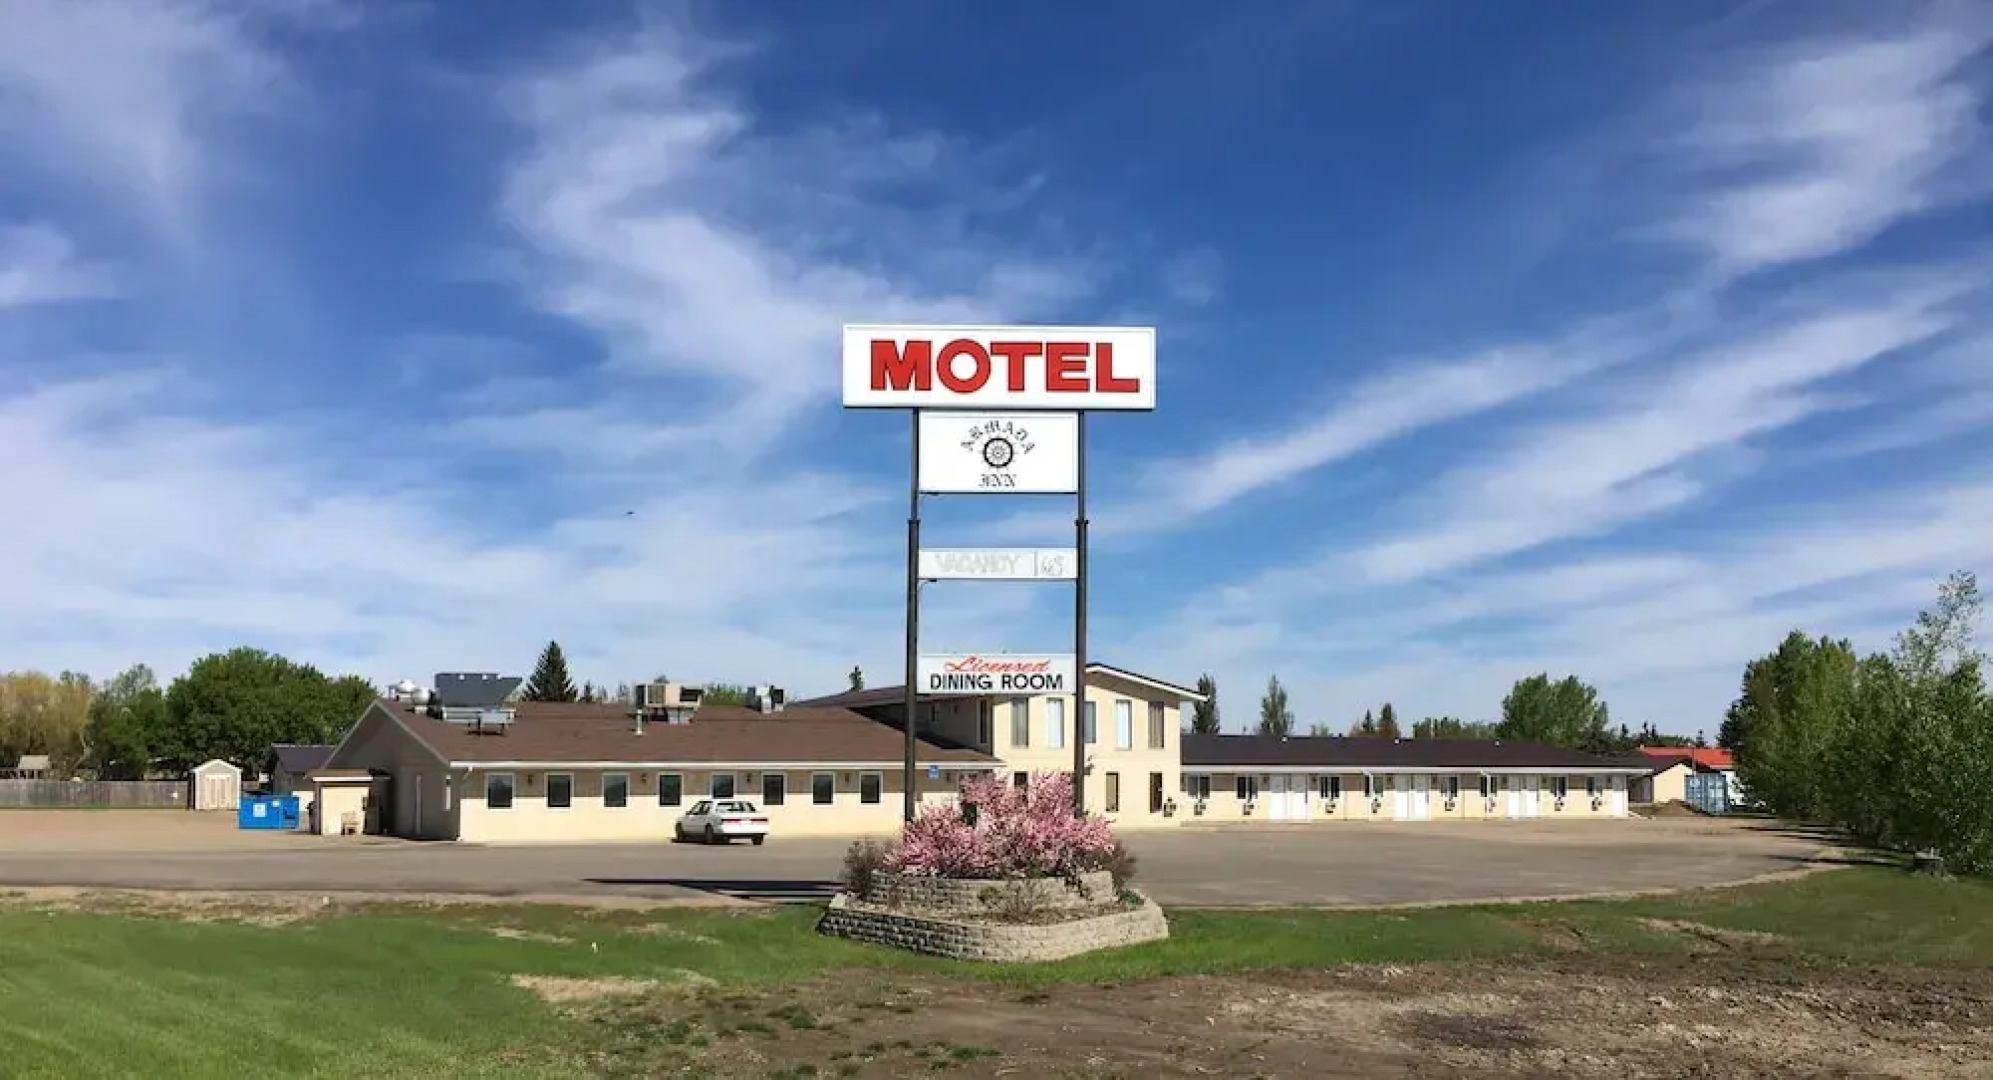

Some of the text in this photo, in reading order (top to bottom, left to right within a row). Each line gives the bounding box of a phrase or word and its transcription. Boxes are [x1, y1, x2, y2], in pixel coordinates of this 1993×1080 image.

[870, 339, 1140, 393] MOTEL
[960, 420, 1036, 454] ARMADA
[945, 654, 1051, 673] Licensed
[930, 673, 1063, 690] DINING ROOM
